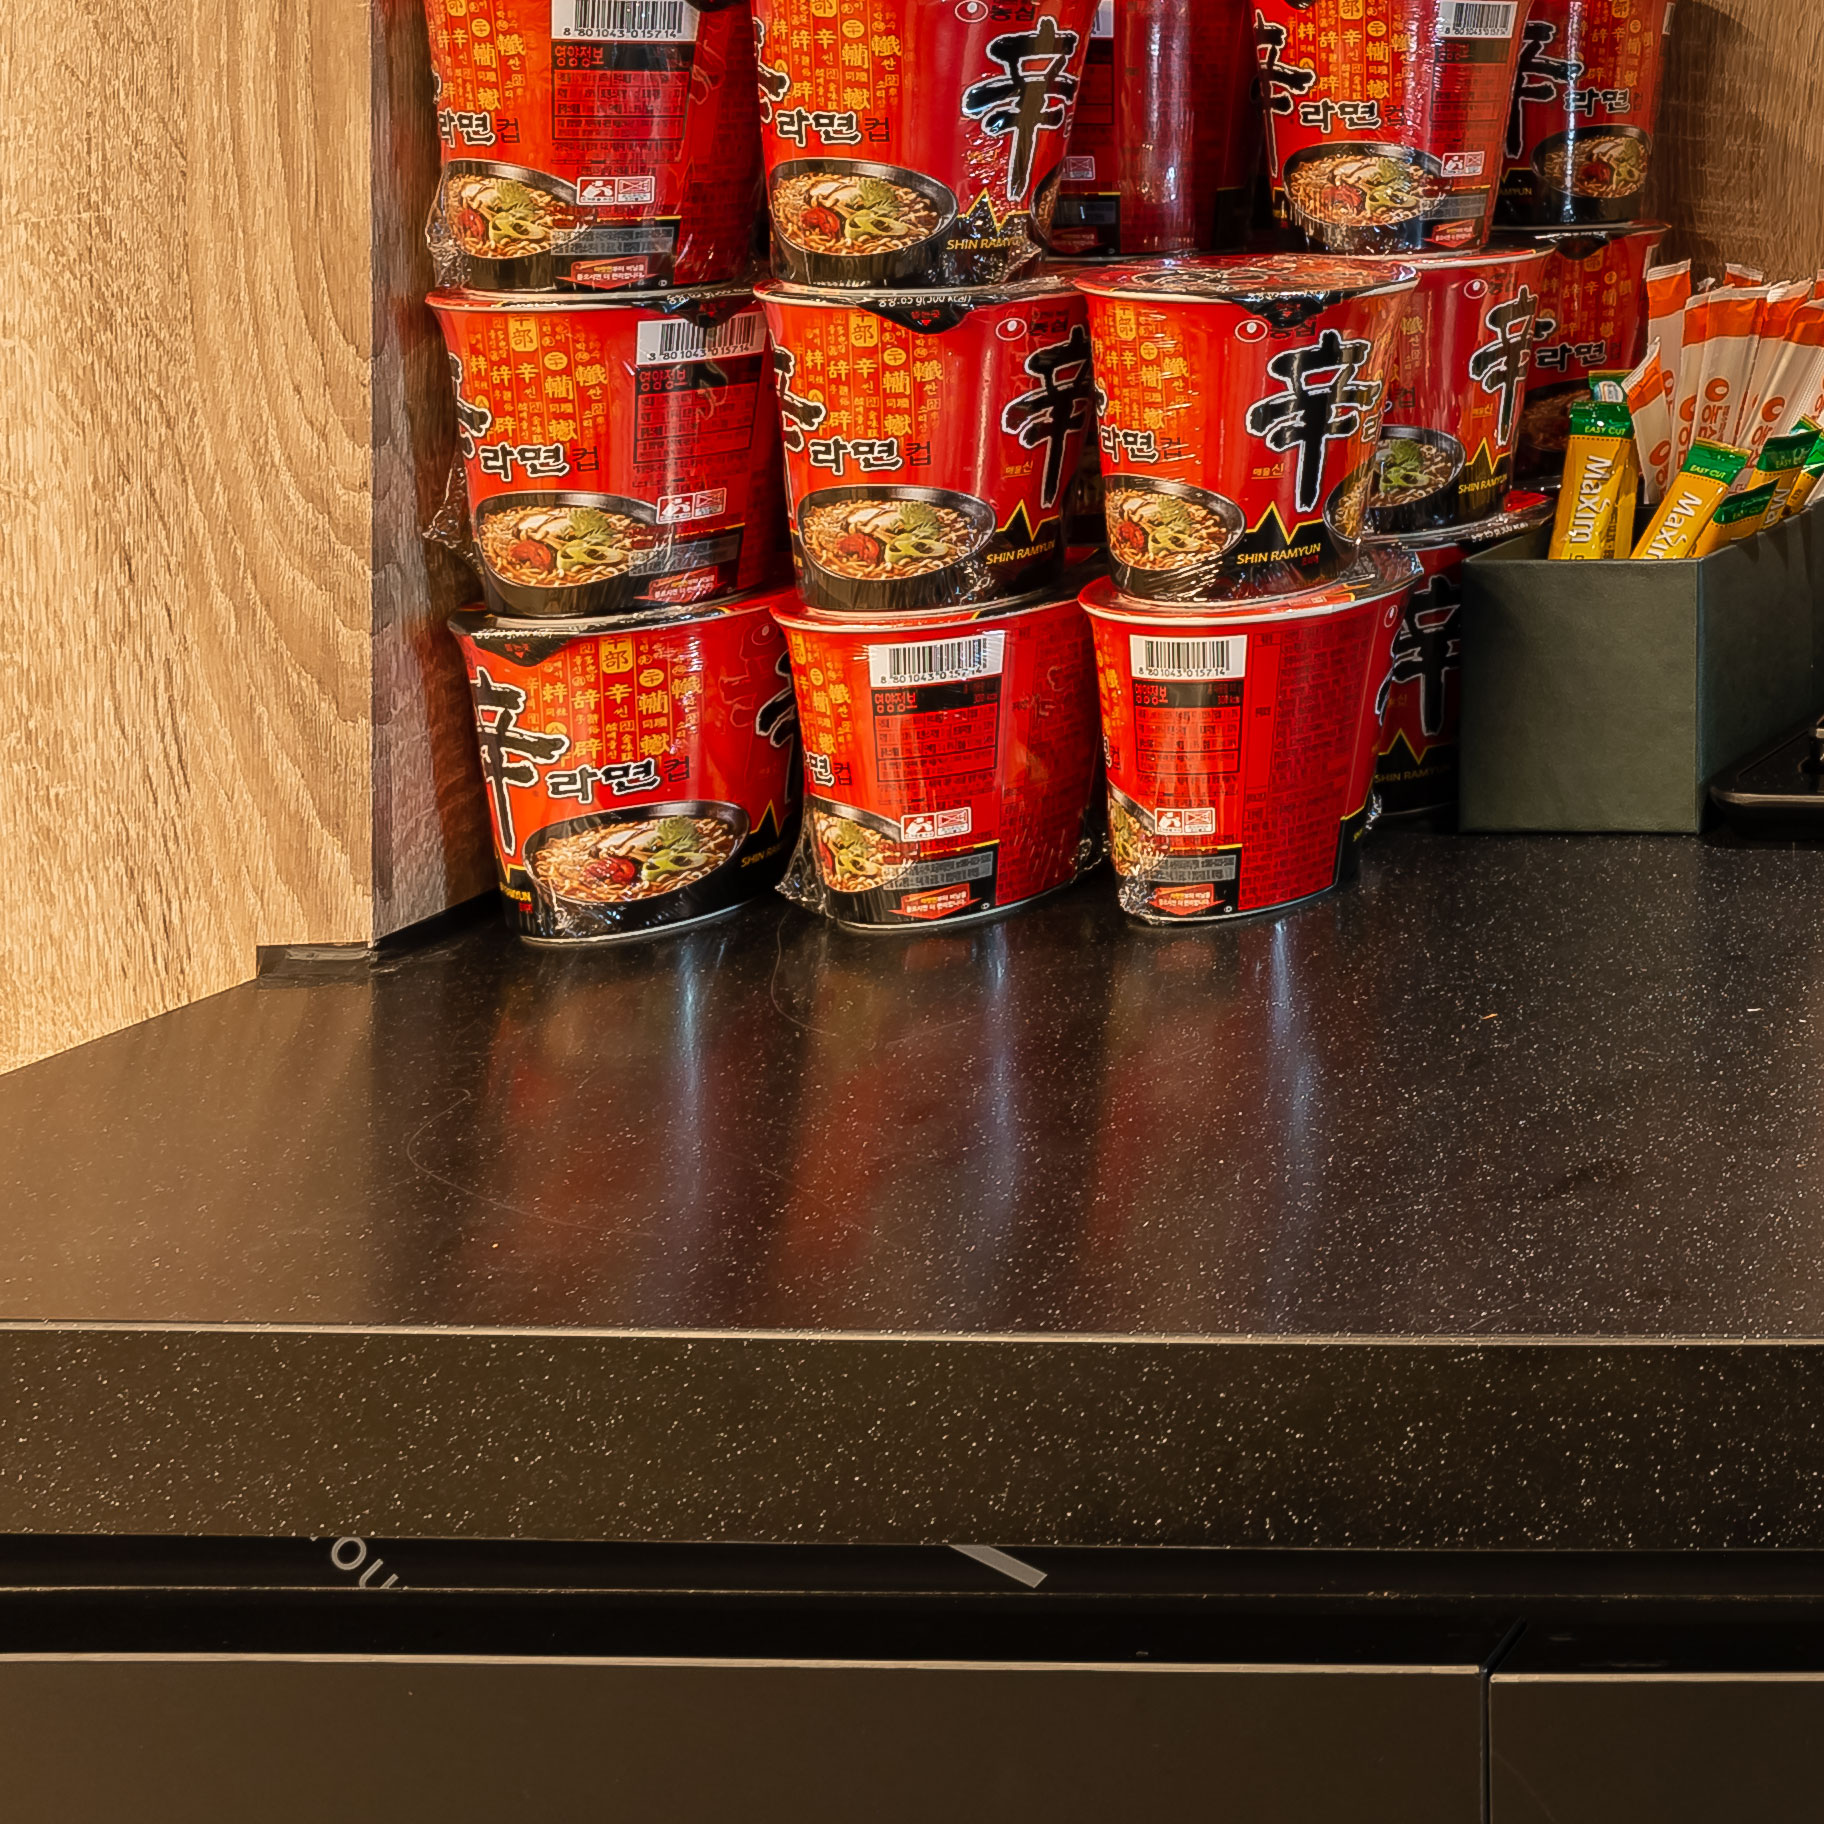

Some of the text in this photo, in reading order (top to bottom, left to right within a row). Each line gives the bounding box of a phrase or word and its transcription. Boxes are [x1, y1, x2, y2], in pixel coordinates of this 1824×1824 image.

[962, 16, 1079, 202] 辛
[1299, 98, 1381, 135] 라면
[1562, 87, 1632, 118] 라면
[776, 107, 891, 148] 라면 컵
[1469, 285, 1538, 446] 辛
[1535, 341, 1608, 373] 라면
[1001, 324, 1098, 510] 辛
[1246, 328, 1383, 513] 辛
[1584, 425, 1626, 436] EASY CUT
[478, 442, 600, 482] 라면 컵
[807, 436, 932, 476] 라면 컵
[1100, 424, 1159, 464] 라면
[1689, 464, 1727, 480] EASY CUT
[1570, 455, 1613, 544] Maxim
[985, 552, 1015, 565] SHIN
[1236, 551, 1269, 565] SHIN
[1270, 542, 1321, 563] RAMYUN
[880, 674, 888, 684] 8
[546, 755, 691, 805] 라면 컵
[805, 752, 836, 788] 면
